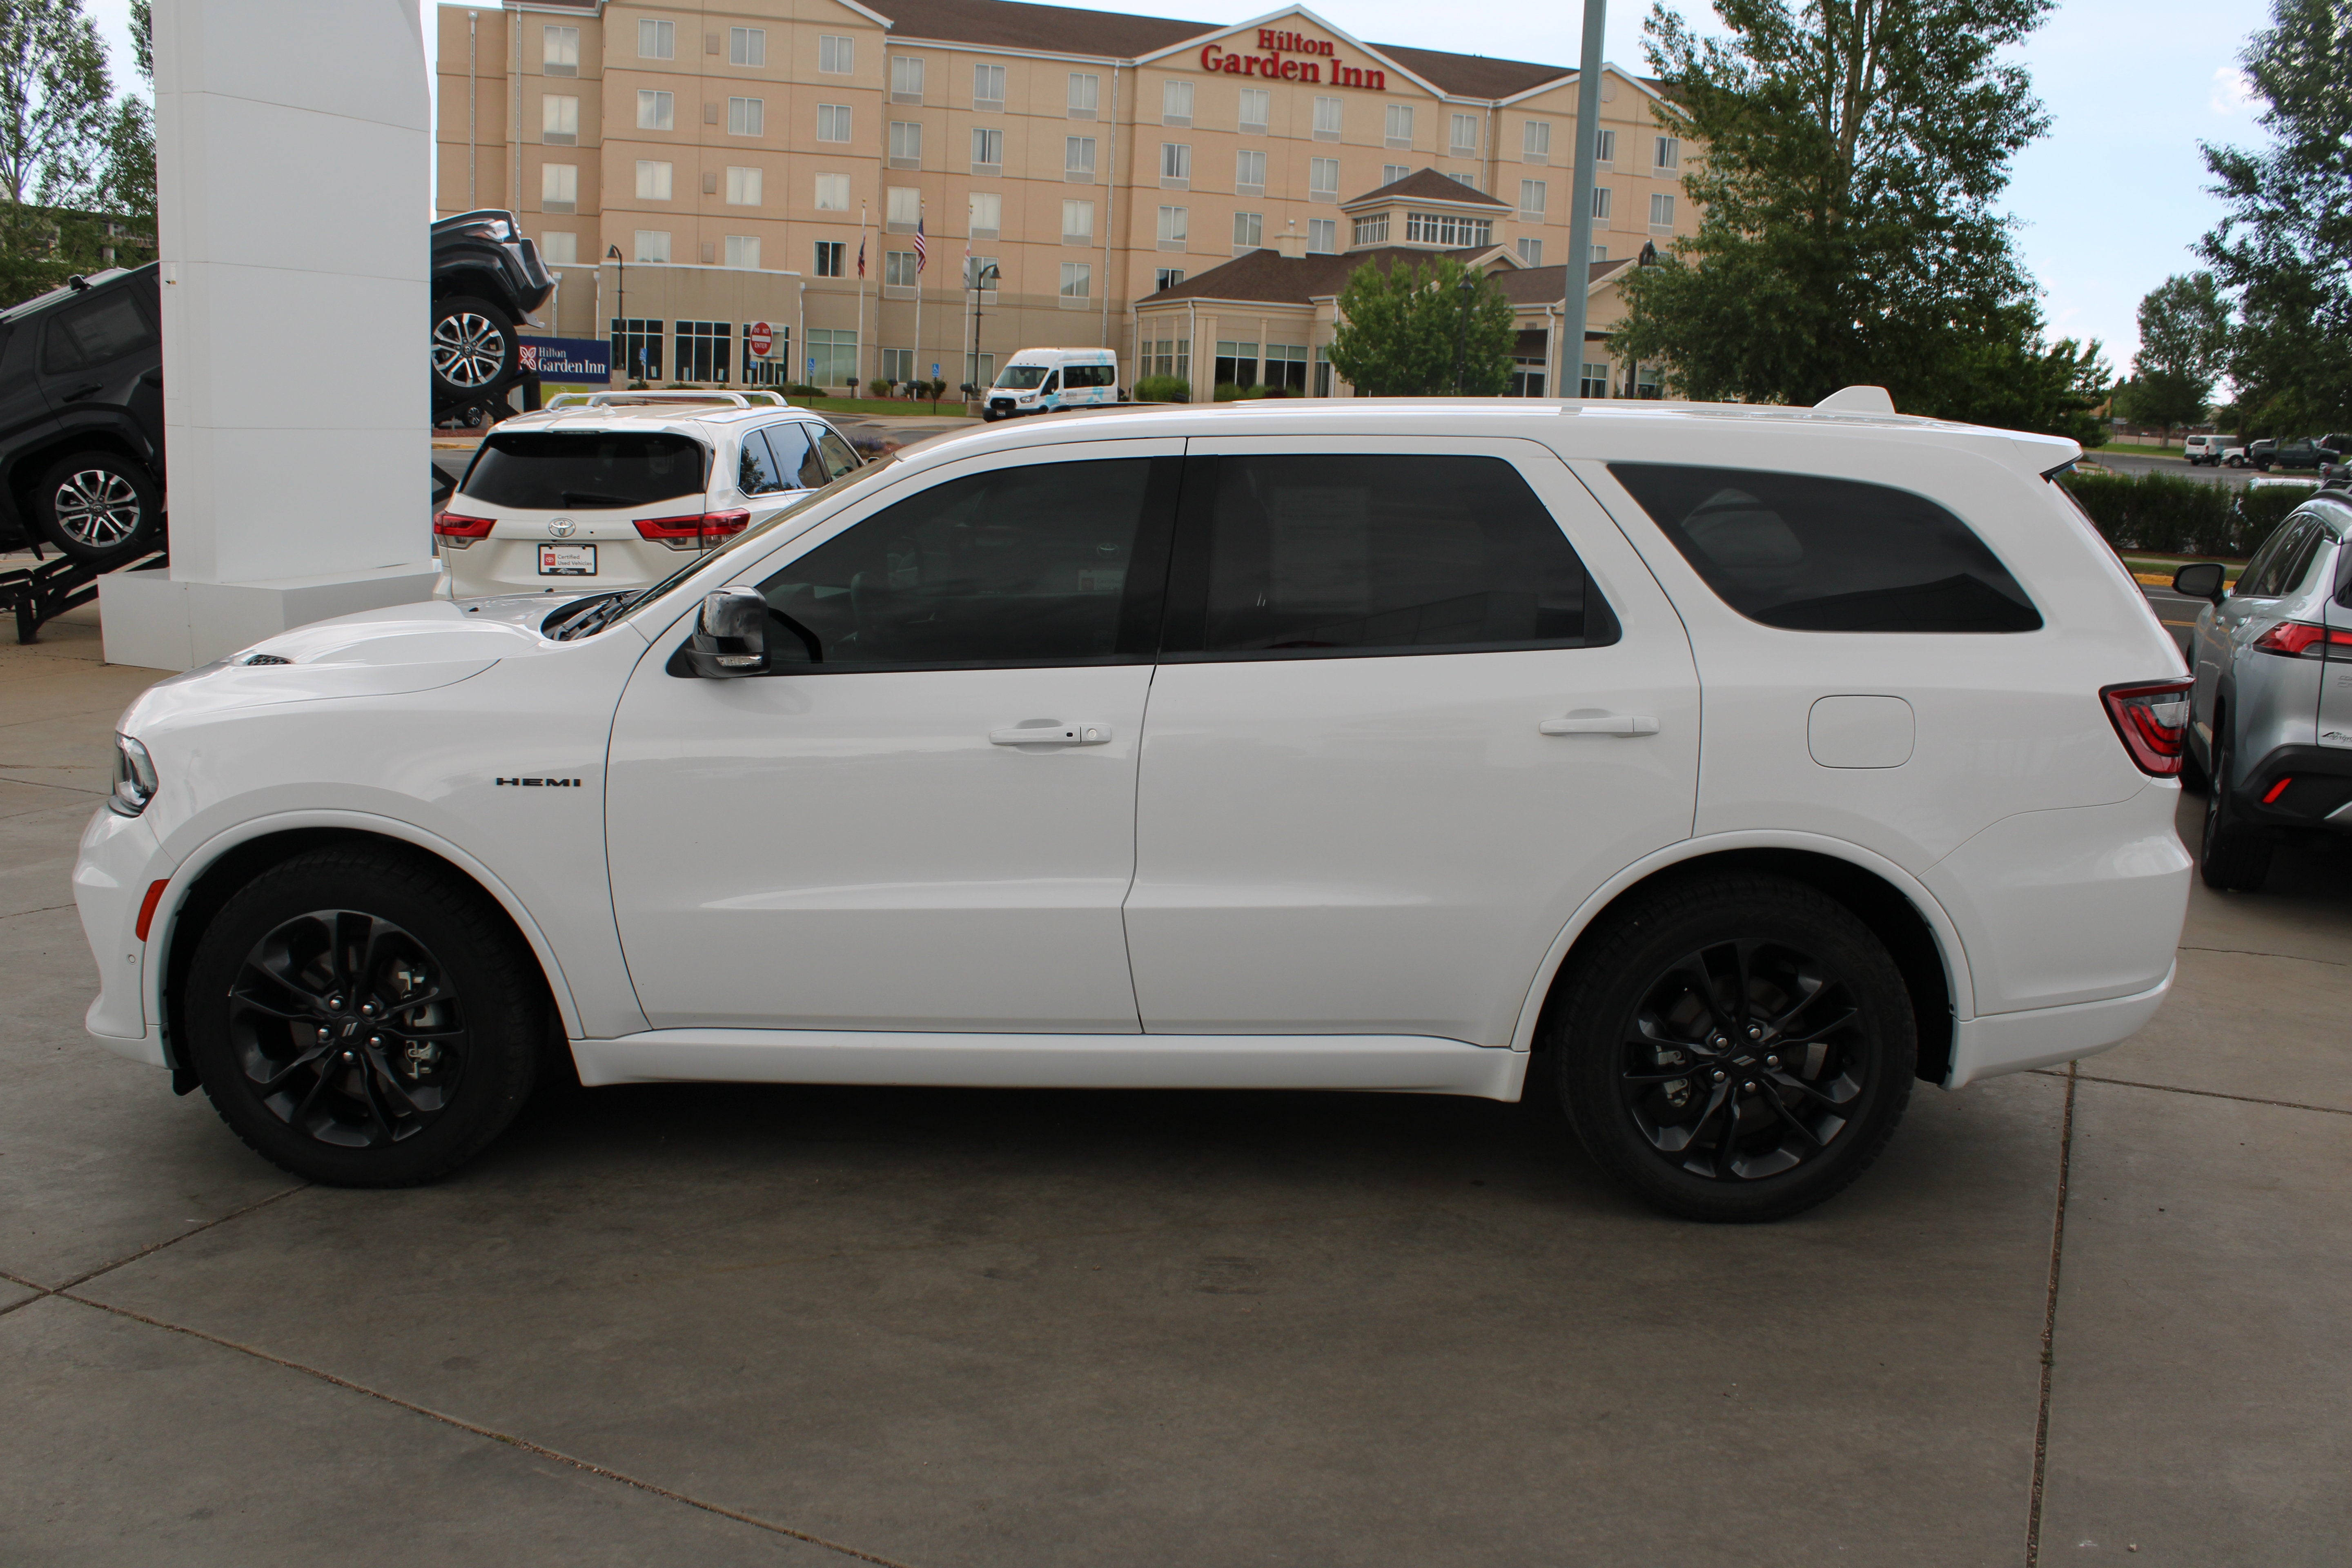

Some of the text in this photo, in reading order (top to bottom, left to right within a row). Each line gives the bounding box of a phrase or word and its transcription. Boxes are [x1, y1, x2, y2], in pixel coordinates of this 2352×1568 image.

[1258, 28, 1334, 56] Hilton
[1200, 44, 1386, 90] Garden Inn
[538, 346, 566, 358] Hilton
[538, 358, 606, 374] Garden Inn
[496, 777, 581, 787] HEMI
